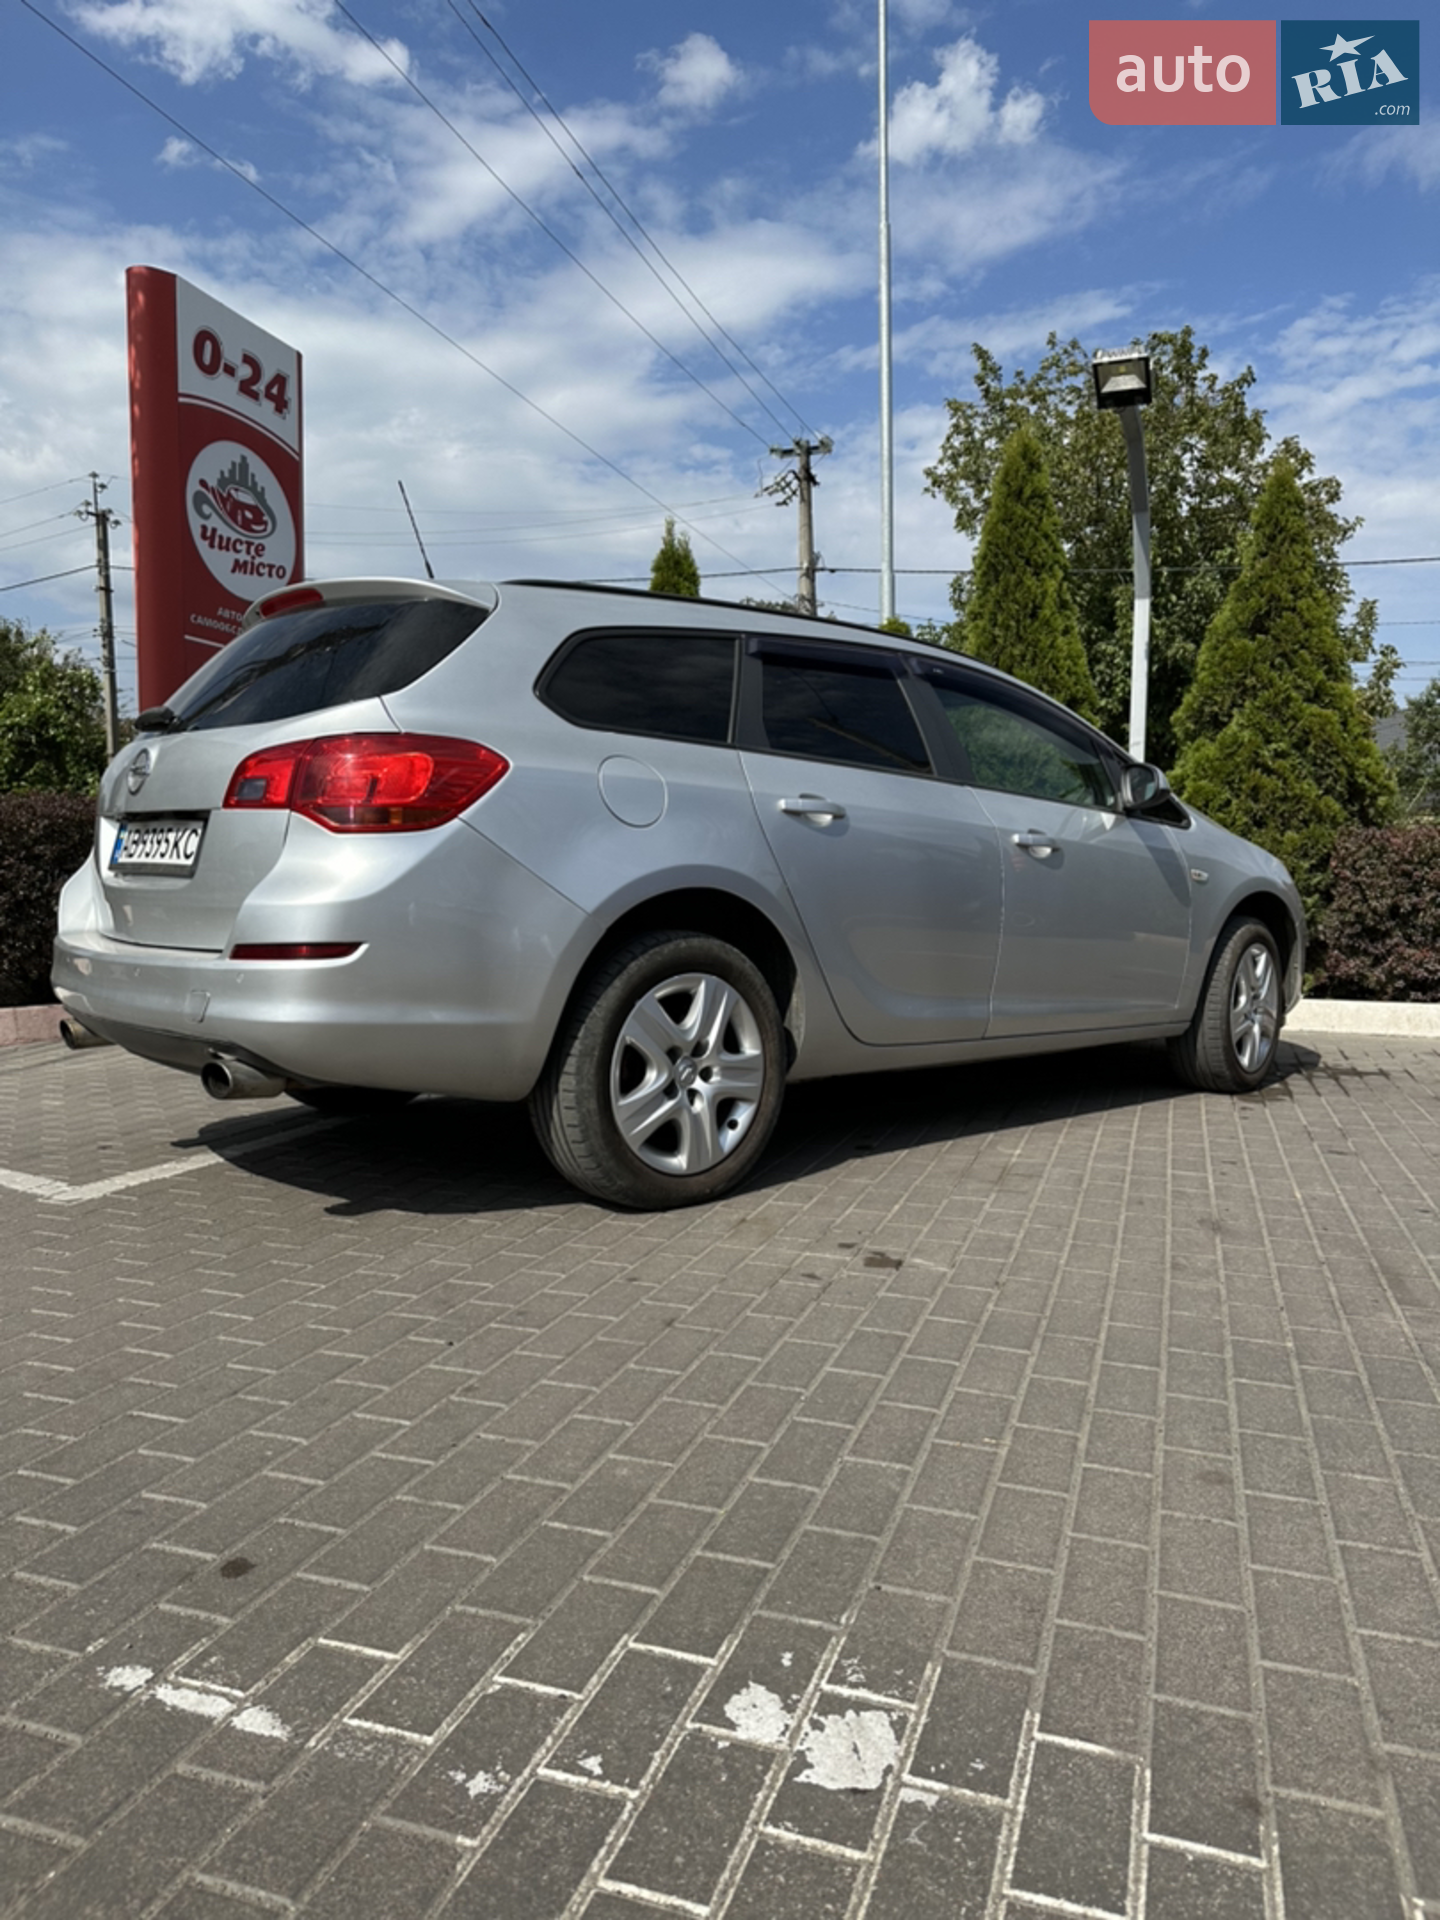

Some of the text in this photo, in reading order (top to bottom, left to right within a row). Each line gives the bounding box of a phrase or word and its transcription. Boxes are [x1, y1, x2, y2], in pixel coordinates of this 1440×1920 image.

[192, 328, 290, 417] 0-24
[200, 524, 266, 558] Чисте
[230, 555, 287, 580] місто
